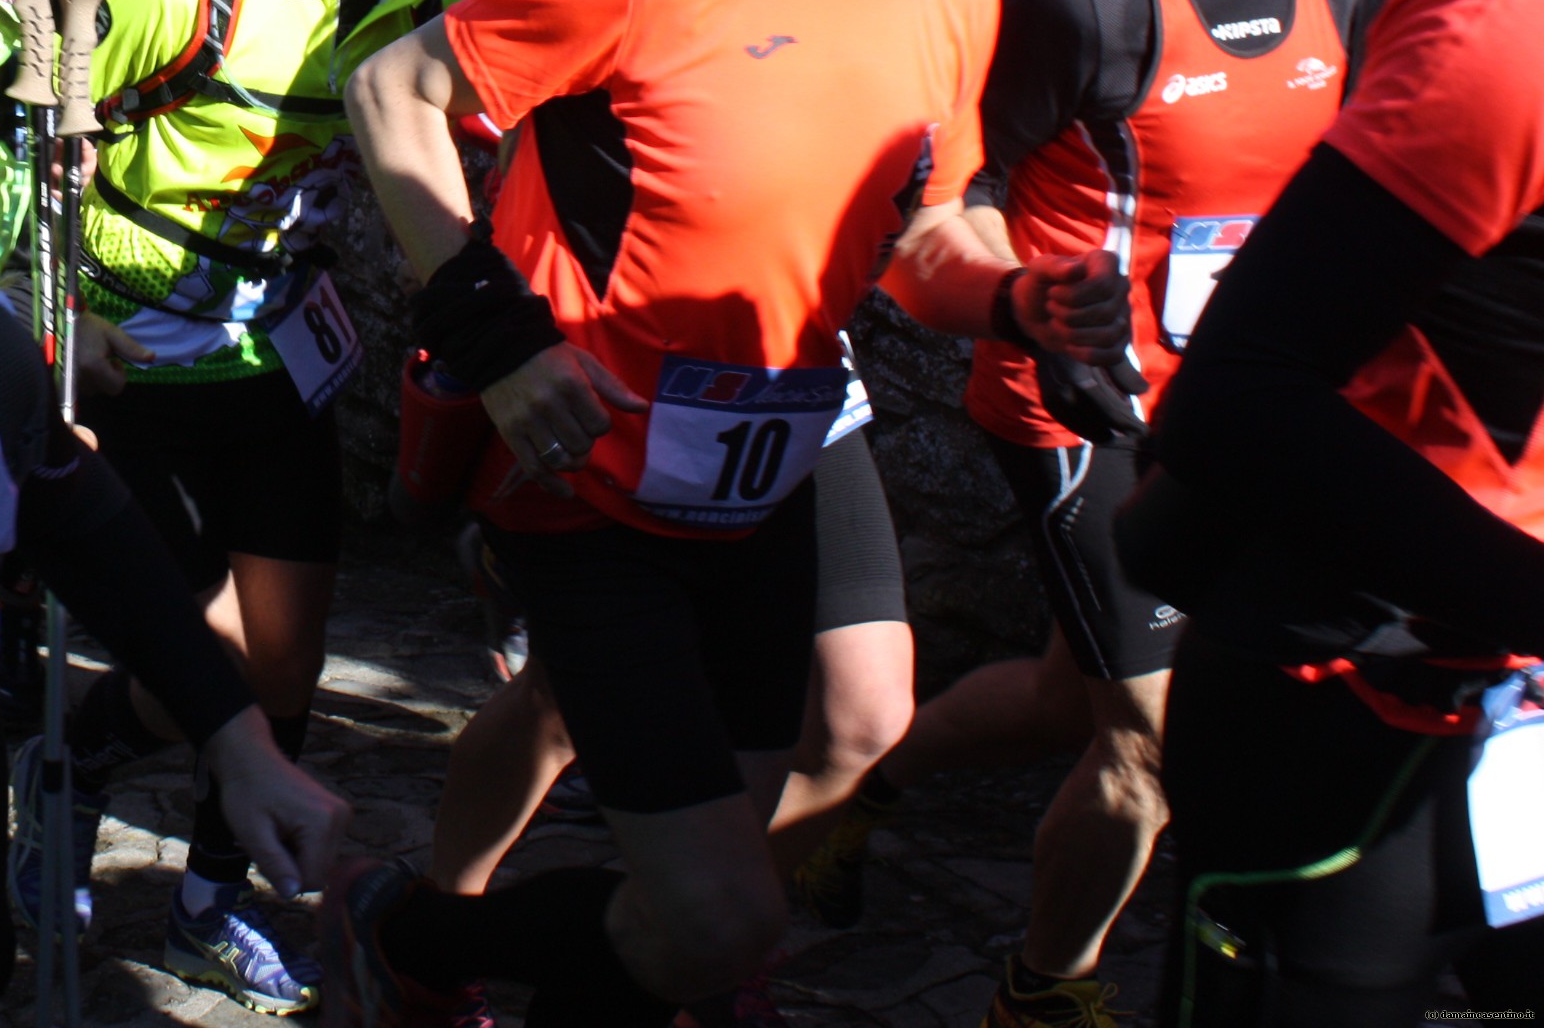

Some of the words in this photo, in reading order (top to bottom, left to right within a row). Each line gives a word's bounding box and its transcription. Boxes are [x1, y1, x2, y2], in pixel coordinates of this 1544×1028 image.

[1185, 71, 1228, 97] asics
[303, 285, 353, 365] 81
[711, 418, 792, 502] 10
